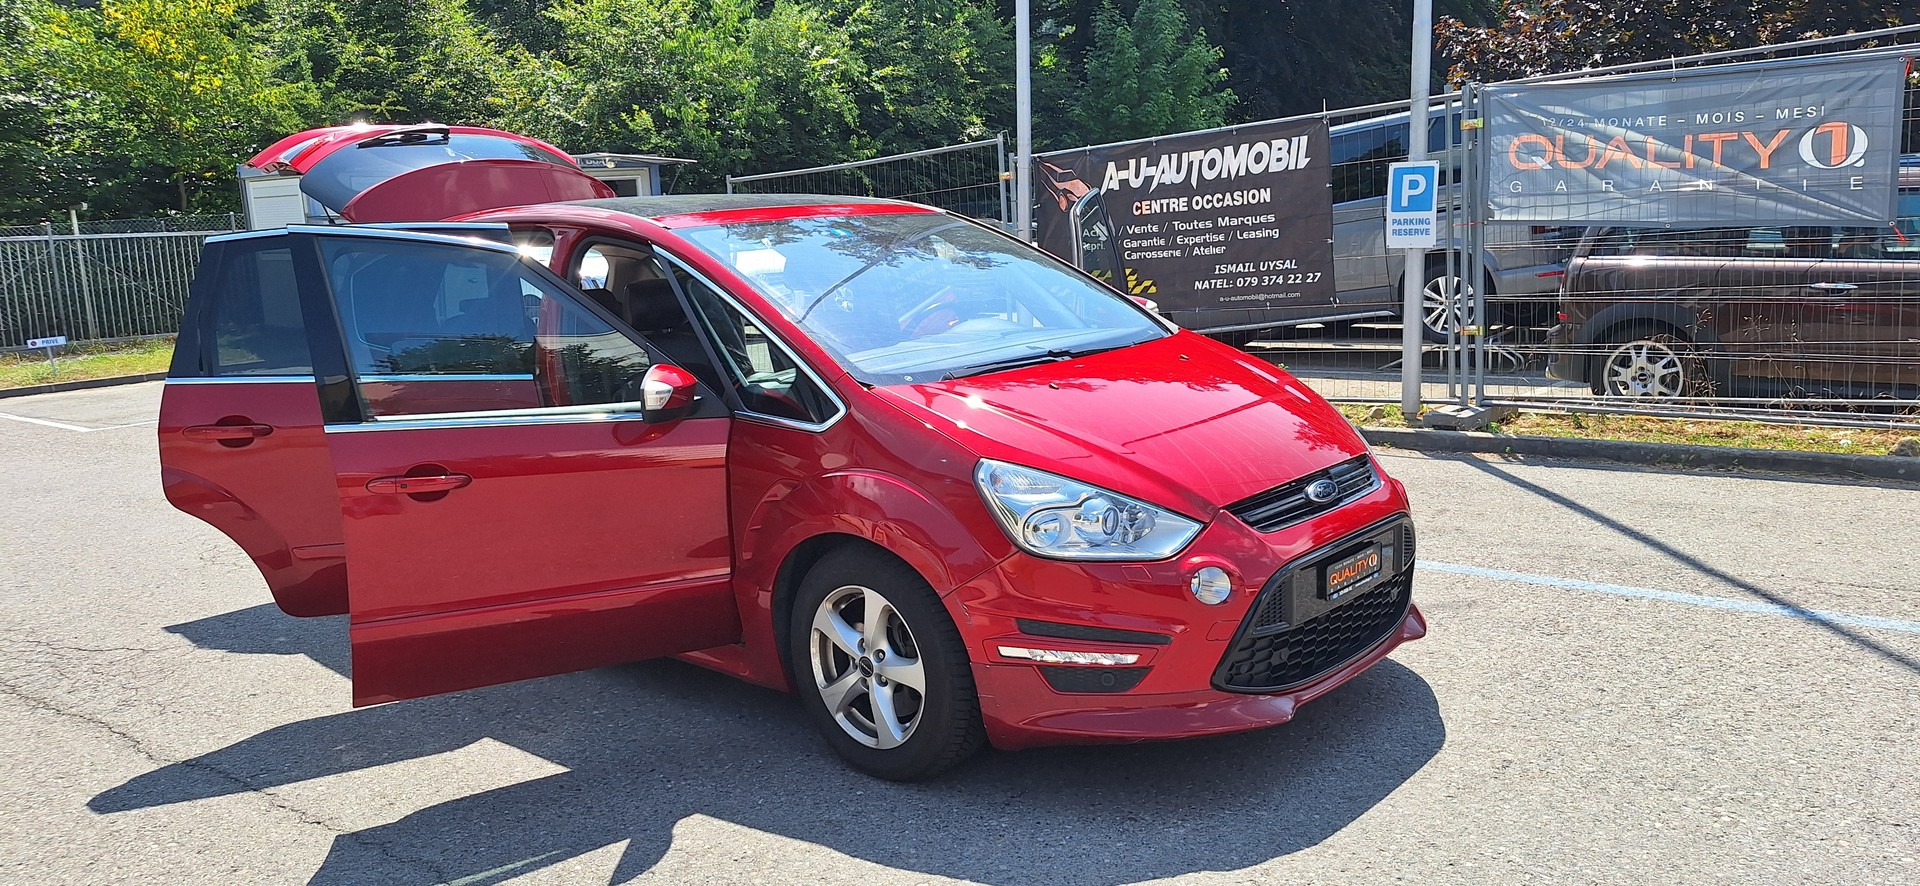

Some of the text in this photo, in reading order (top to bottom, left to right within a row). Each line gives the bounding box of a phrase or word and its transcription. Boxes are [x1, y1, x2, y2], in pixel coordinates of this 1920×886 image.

[1594, 115, 1667, 128] MONATE
[1696, 111, 1745, 124] MOIS
[1776, 105, 1825, 120] MESI
[1508, 129, 1791, 170] QUALITY
[1100, 135, 1311, 196] A-U-AUTOMOBIL
[1401, 174, 1427, 207] P
[1509, 176, 1863, 193] GARANTIE
[1132, 187, 1271, 216] CENTRE OCCASION
[1126, 224, 1159, 235] Vente
[1172, 218, 1213, 231] Toutes
[1218, 213, 1276, 229] Marques
[1391, 217, 1431, 226] PARKING
[1123, 236, 1166, 249] Garantie
[1176, 232, 1225, 248] Expertise
[1236, 228, 1280, 243] Leasing
[1391, 228, 1431, 236] RESERVE
[1124, 247, 1181, 260] Carrosserie
[1193, 244, 1227, 256] Atelier
[1214, 259, 1298, 275] ISMAIL UYSAL
[1194, 272, 1322, 290] NATEL: 079 374 22 27
[1219, 292, 1301, 302] a-u-automobil@hotmail.com
[1316, 483, 1334, 497] Ford
[1330, 557, 1369, 585] QUALITY
